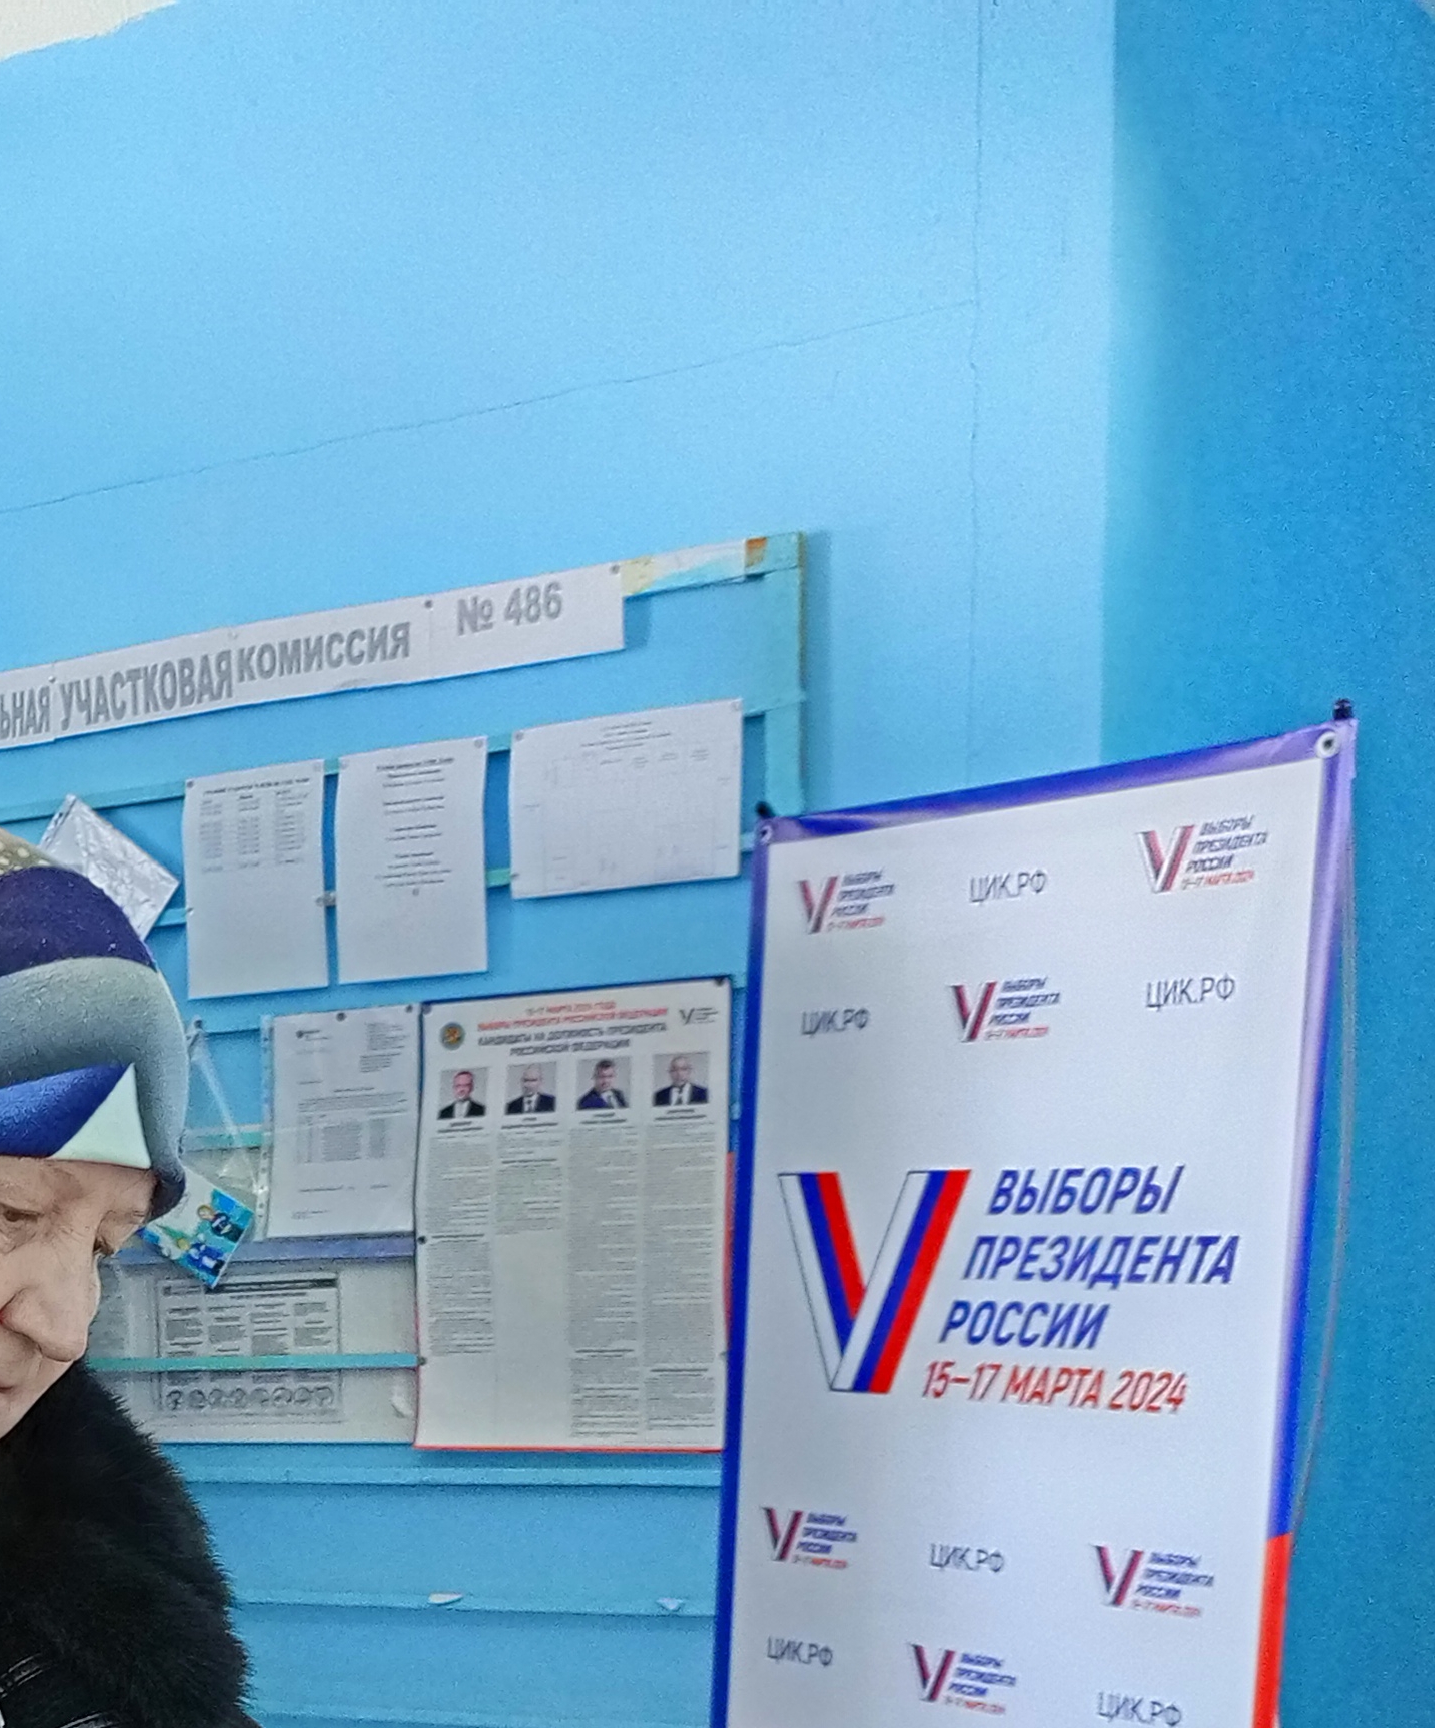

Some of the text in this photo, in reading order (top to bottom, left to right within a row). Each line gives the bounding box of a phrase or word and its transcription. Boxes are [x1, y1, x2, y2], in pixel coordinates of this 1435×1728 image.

[57, 647, 233, 732] УЧАСТКОВАЯ
[236, 621, 411, 684] КОМИССИЯ
[456, 596, 494, 637] №
[503, 581, 563, 626] 486
[1146, 972, 1235, 1012] ЦИК.РФ
[988, 1164, 1185, 1216] ВЫБОРЫ
[961, 1235, 1239, 1290] ПРЕЗИДЕНТА
[938, 1300, 1110, 1349] РОССИИ
[998, 1362, 1105, 1409] МАРТА
[1108, 1370, 1187, 1413] 2024
